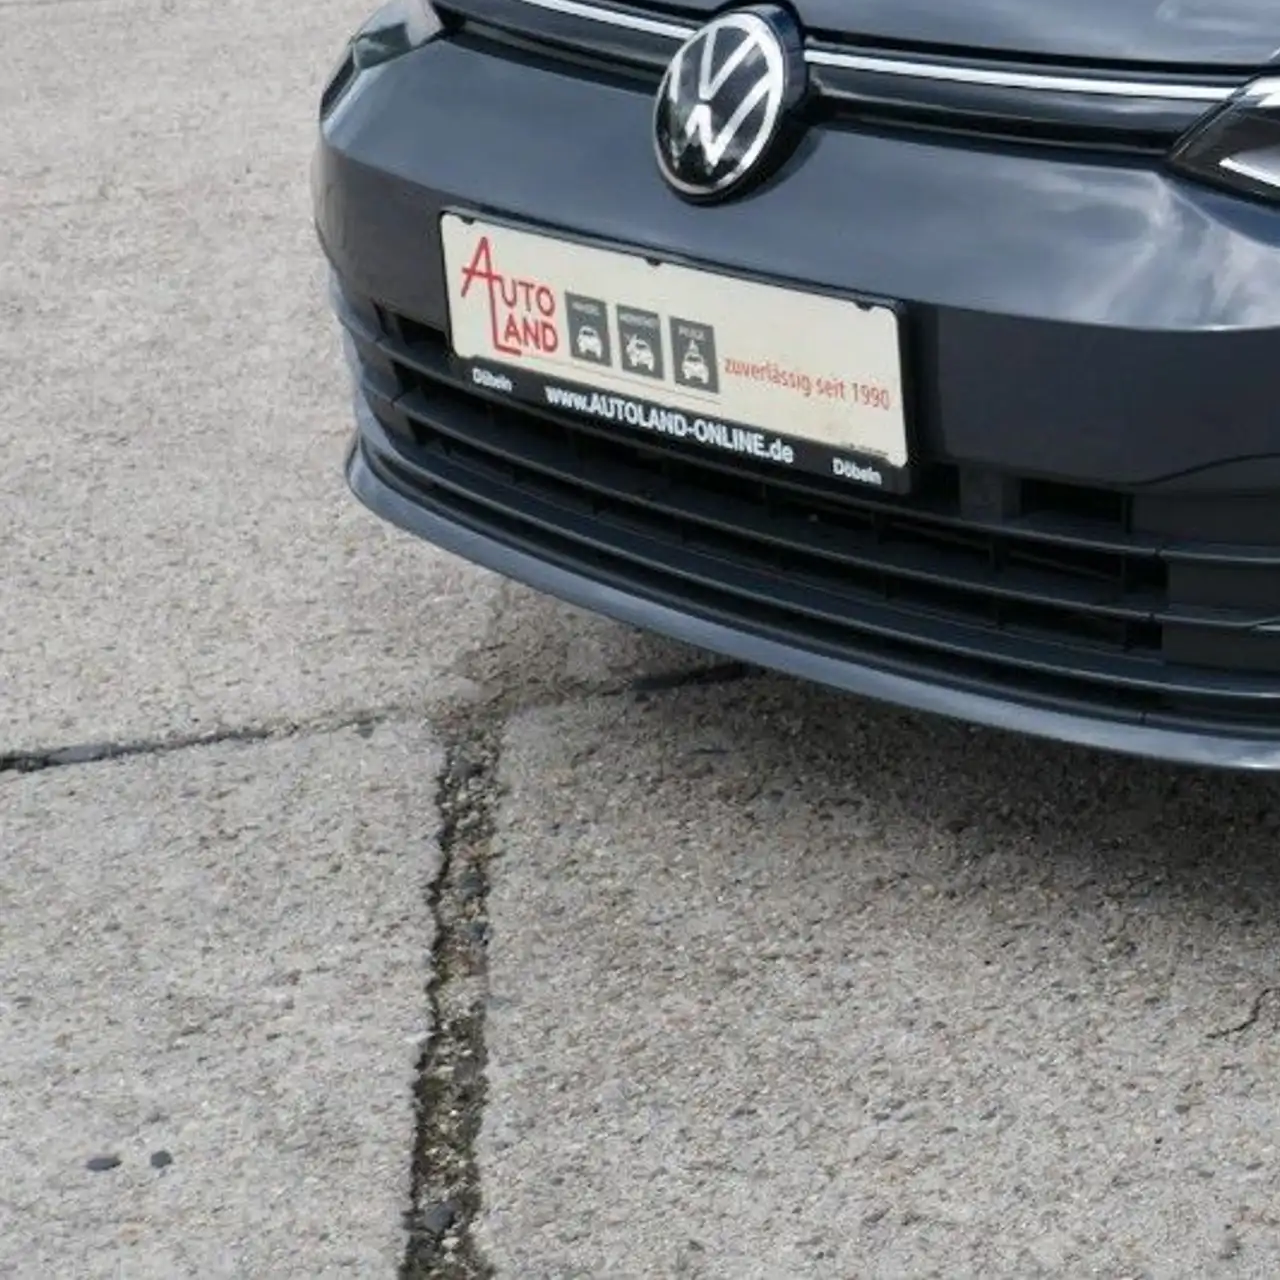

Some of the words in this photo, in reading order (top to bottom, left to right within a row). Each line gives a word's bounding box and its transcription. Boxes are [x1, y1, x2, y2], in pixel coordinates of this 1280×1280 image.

[461, 236, 556, 316] AUTO
[545, 383, 795, 465] www.AUTOLAND-ONLINE.de
[724, 357, 812, 398] zuverlässig
[816, 378, 846, 400] seit
[851, 382, 891, 412] 1990
